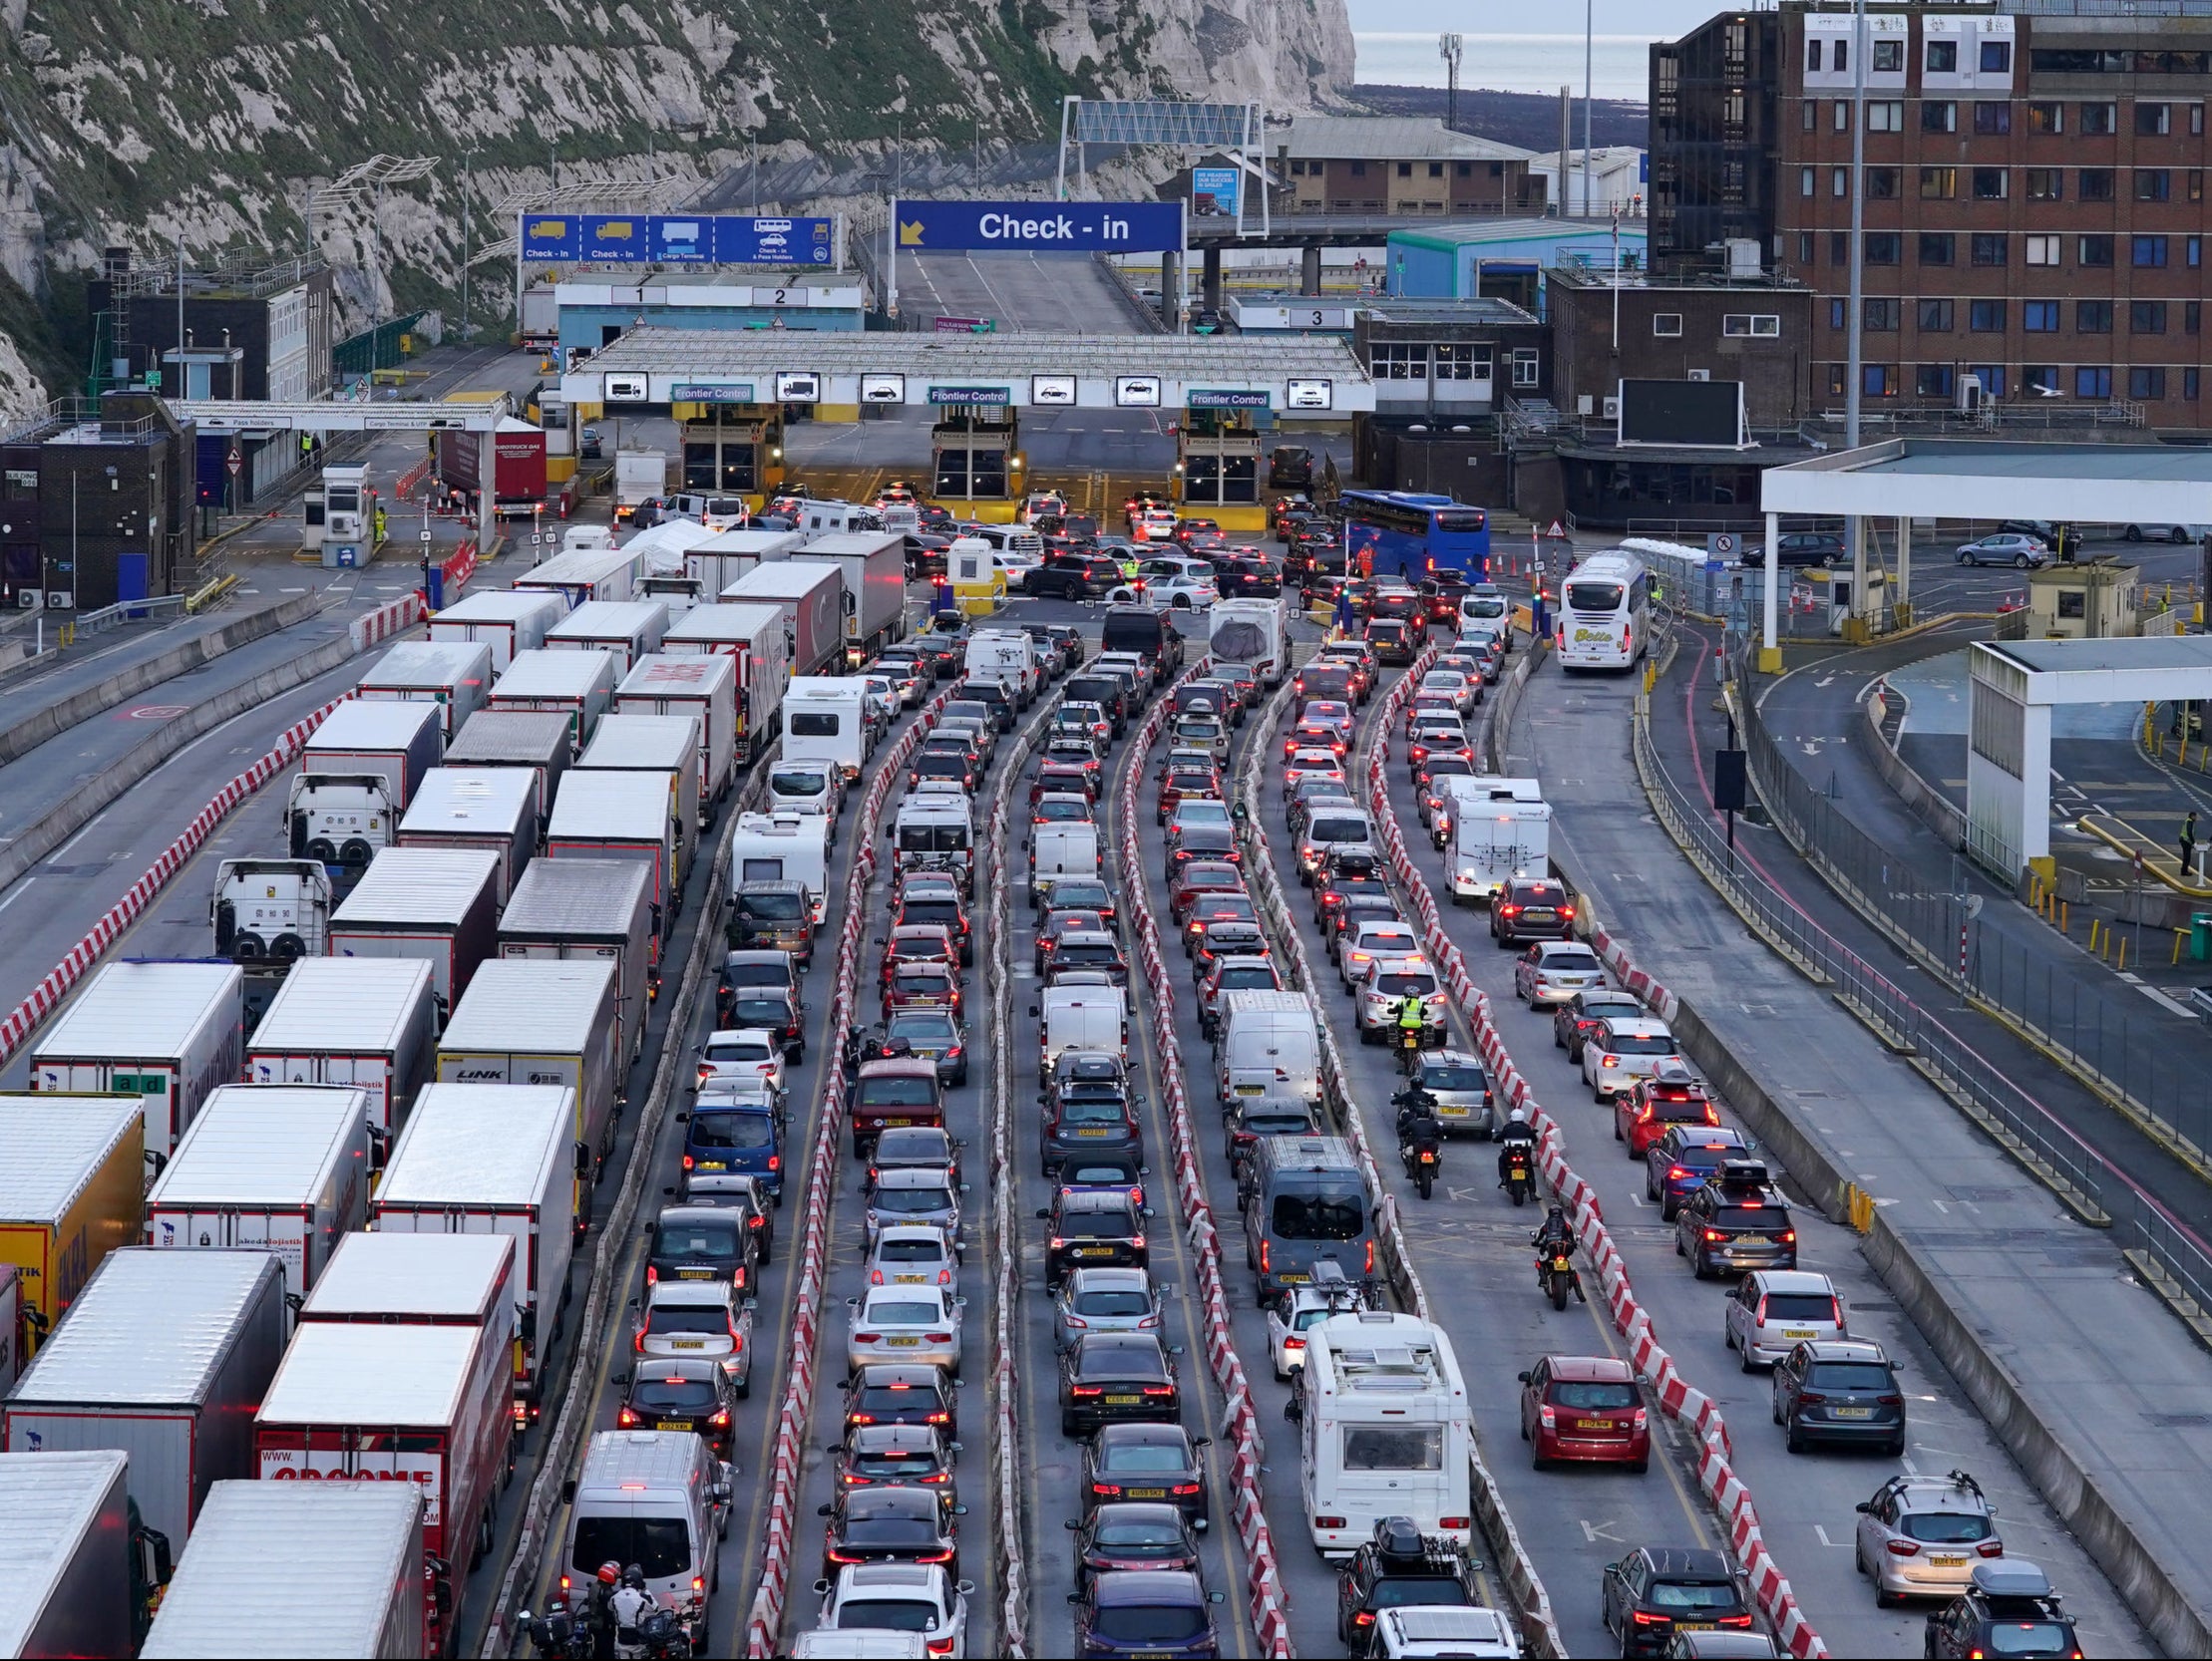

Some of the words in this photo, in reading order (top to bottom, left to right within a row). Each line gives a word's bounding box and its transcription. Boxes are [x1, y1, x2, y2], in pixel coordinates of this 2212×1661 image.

[979, 213, 1074, 239] Check
[1103, 215, 1128, 239] in
[592, 250, 618, 258] Check
[636, 290, 643, 303] 1
[775, 289, 785, 304] 2
[1312, 311, 1322, 326] 3
[675, 389, 714, 398] Frontier
[715, 389, 749, 398] Control
[932, 391, 969, 400] Frontier
[971, 391, 1007, 401] Control
[1192, 394, 1229, 404] Frontier
[1232, 395, 1267, 405] Control
